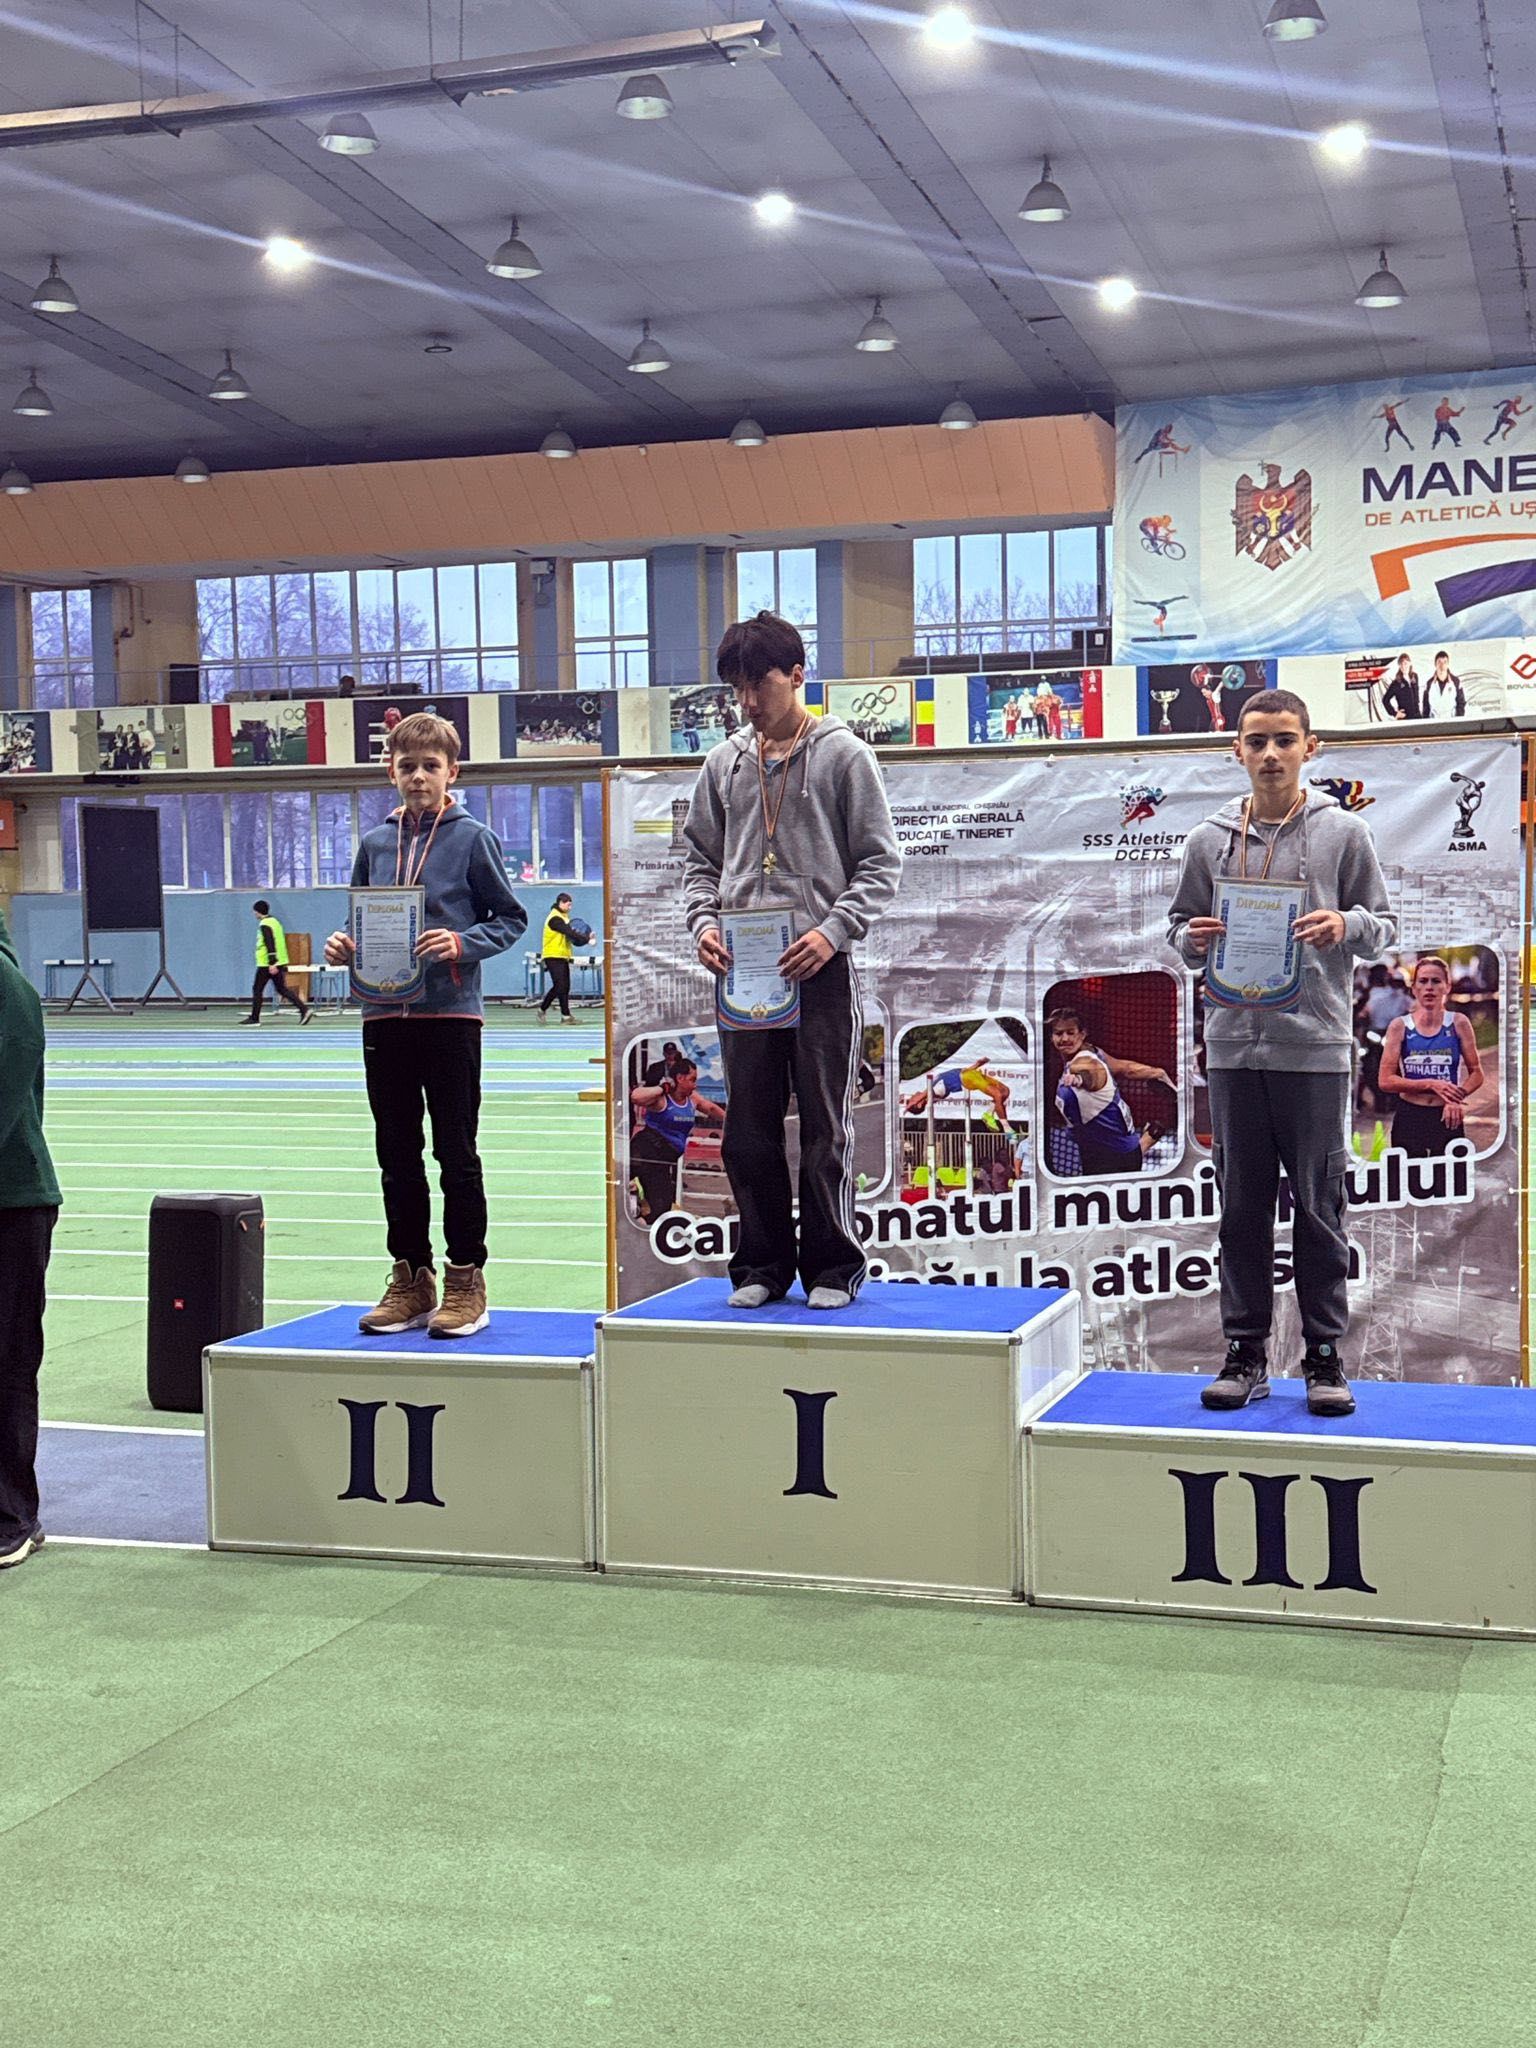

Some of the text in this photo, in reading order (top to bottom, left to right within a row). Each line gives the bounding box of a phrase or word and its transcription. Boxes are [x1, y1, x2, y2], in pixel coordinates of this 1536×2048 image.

[1362, 453, 1536, 504] MANE
[1365, 512, 1393, 527] DE
[1400, 500, 1502, 525] ATLETICĂ
[951, 808, 1026, 824] GENERALĂ
[956, 827, 1015, 840] TINERET
[904, 844, 950, 856] SPORT
[1115, 847, 1173, 861] DGETS
[1447, 841, 1488, 852] ASMA
[1404, 1063, 1451, 1076] MIHAELA
[782, 1388, 838, 1500] I
[337, 1397, 446, 1508] II
[1167, 1468, 1378, 1594] III
